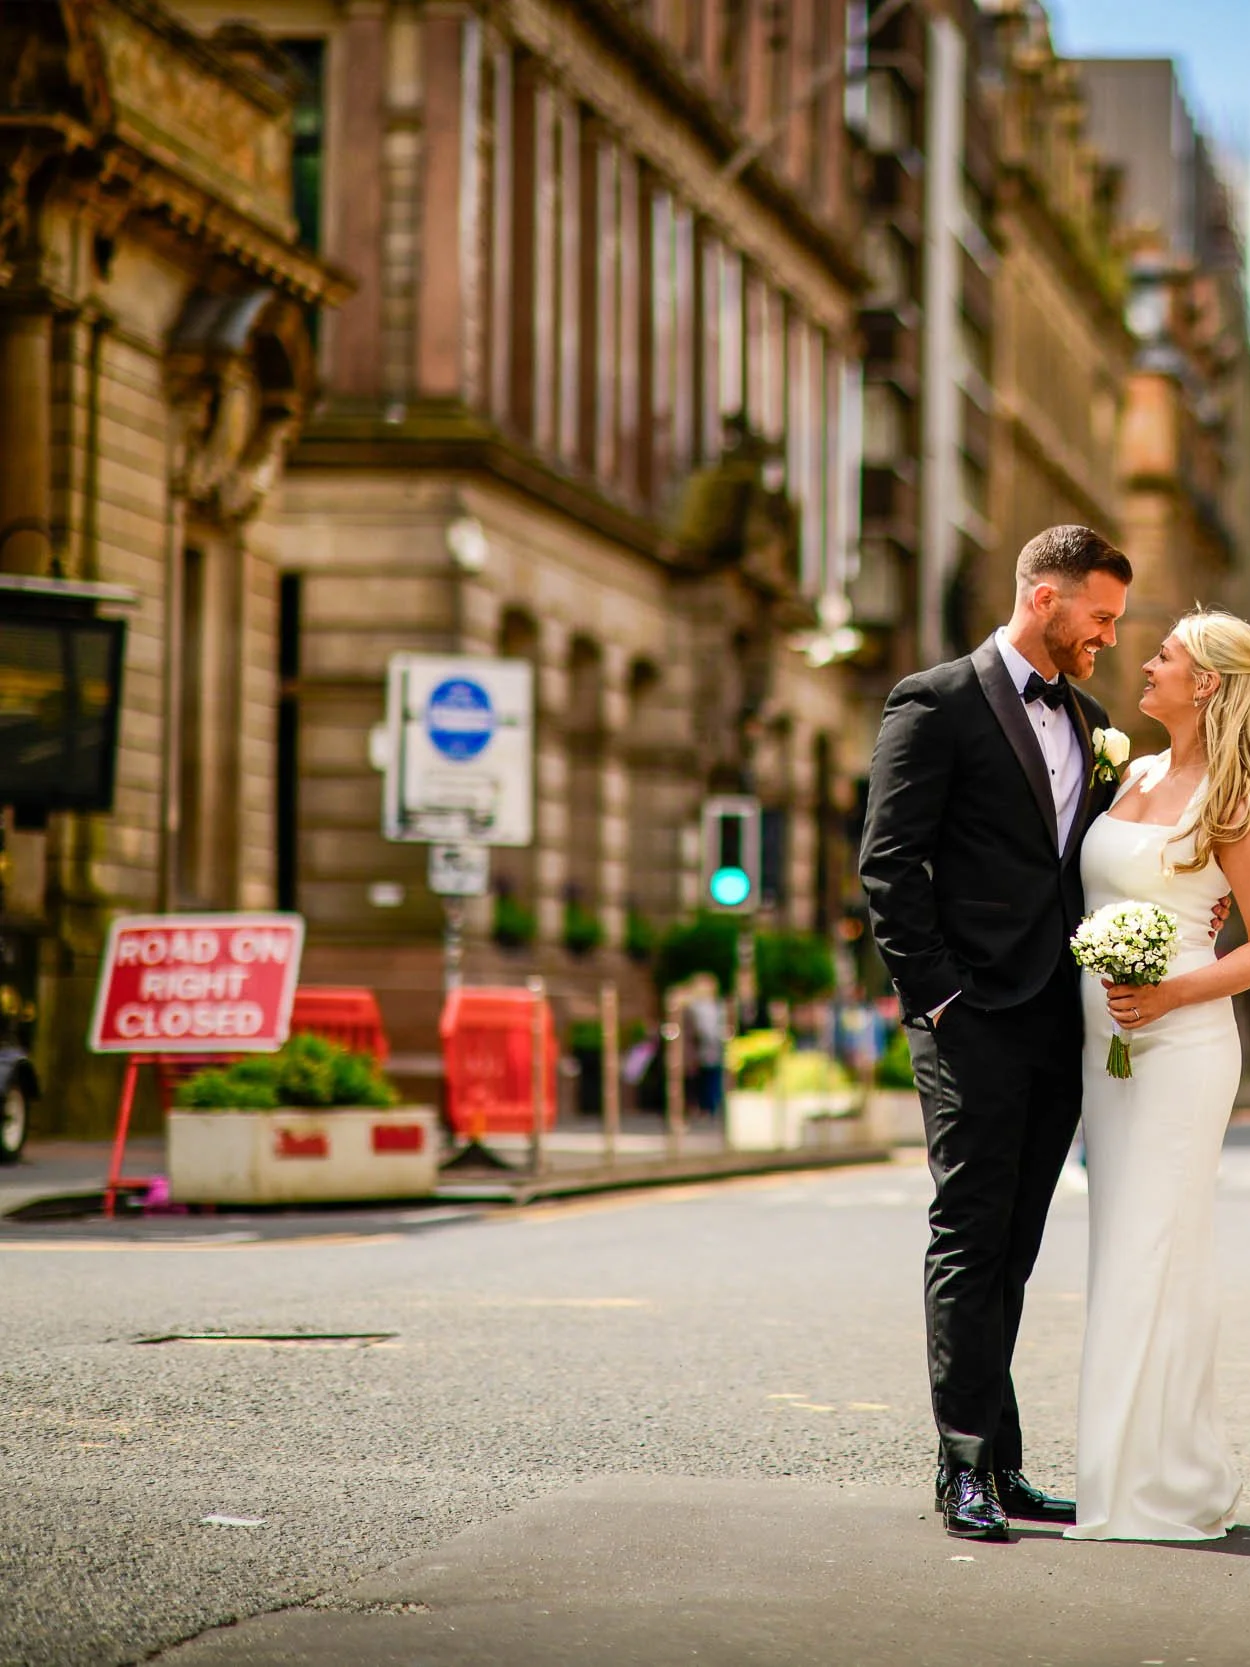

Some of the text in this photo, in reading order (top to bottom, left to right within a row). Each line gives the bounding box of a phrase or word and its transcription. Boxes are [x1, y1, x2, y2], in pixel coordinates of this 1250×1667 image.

[117, 929, 289, 965] ROAD ON
[141, 967, 249, 1000] RIGHT
[115, 1003, 263, 1038] CLOSED
